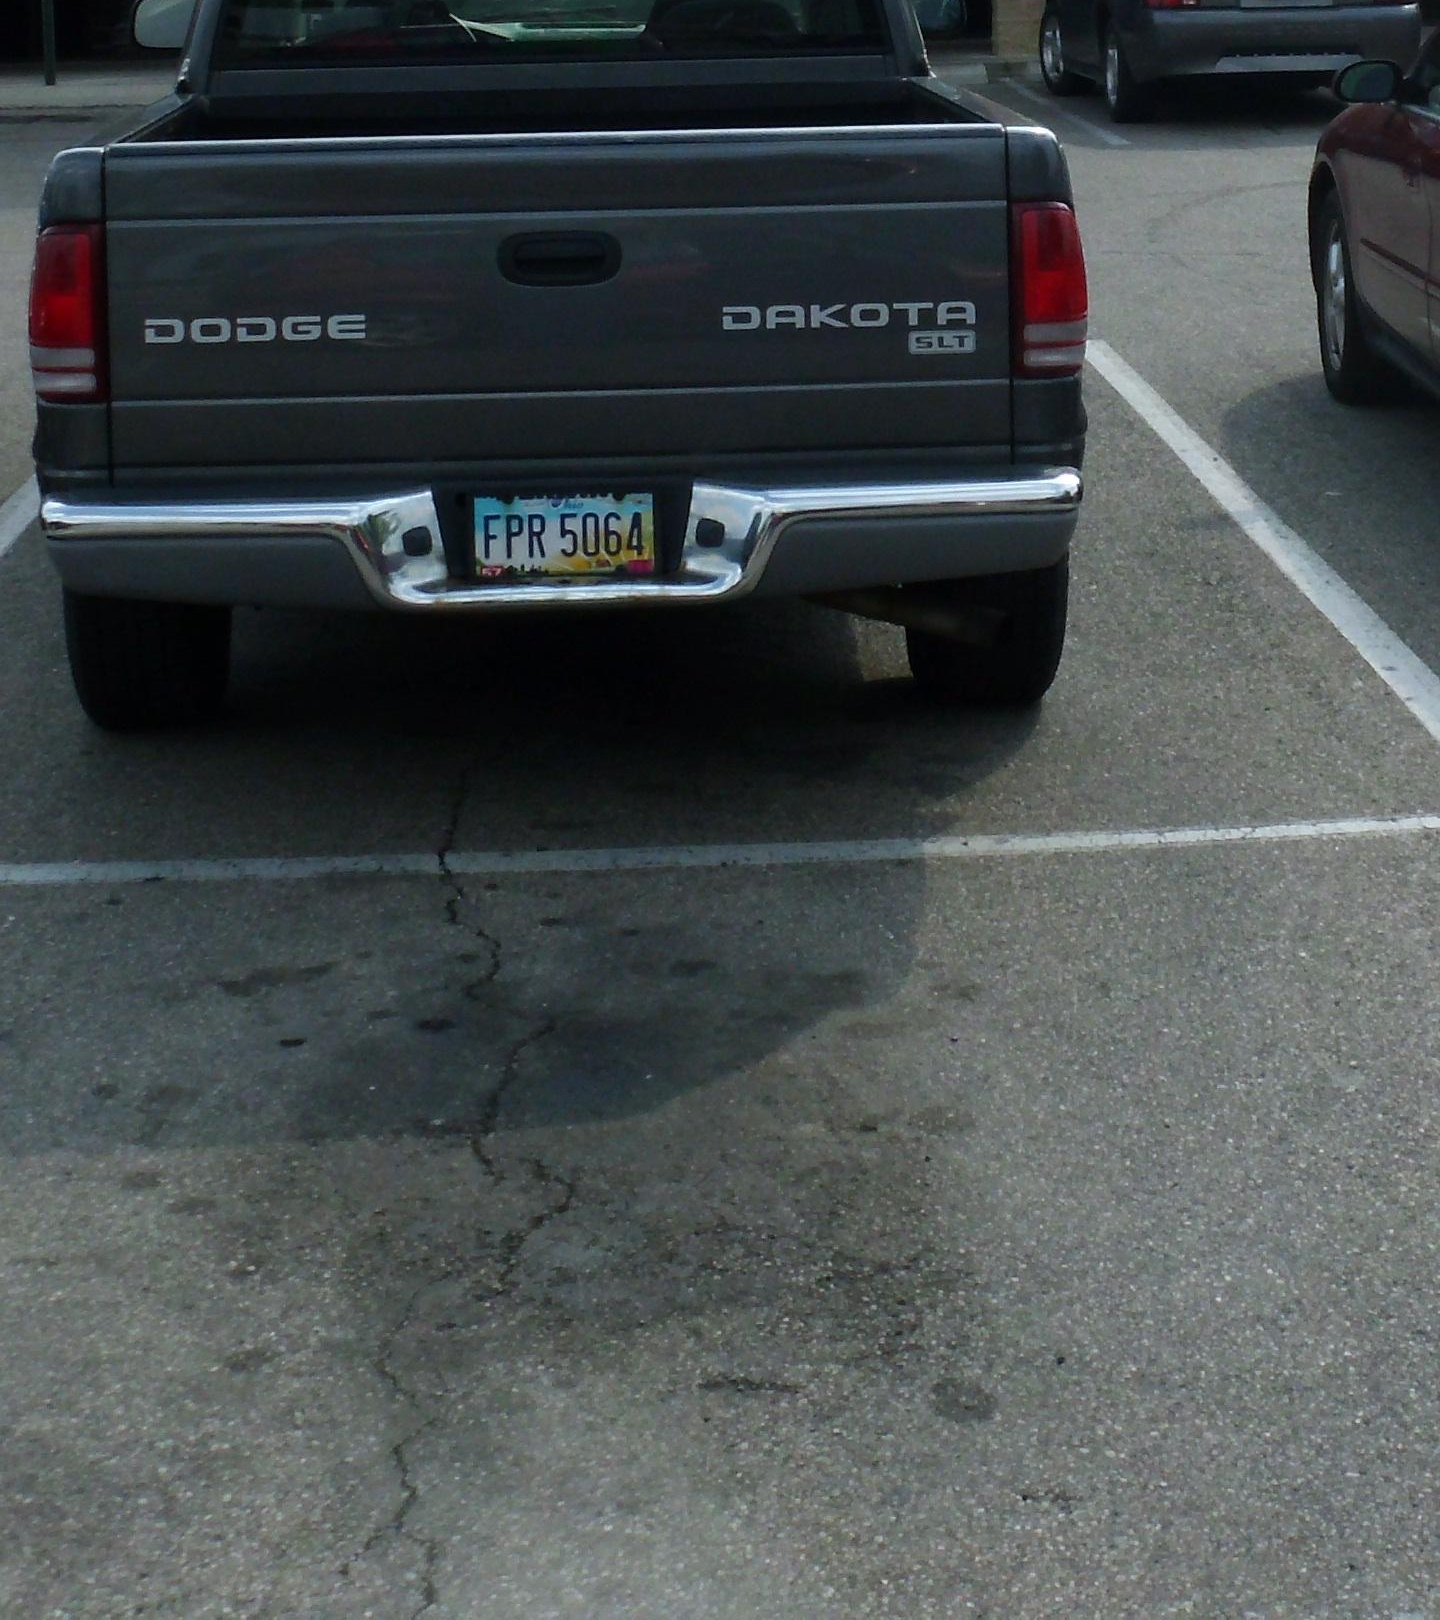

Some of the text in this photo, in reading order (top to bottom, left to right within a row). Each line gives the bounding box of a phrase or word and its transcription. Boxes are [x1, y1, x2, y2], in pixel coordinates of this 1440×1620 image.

[144, 314, 367, 343] DODGE
[722, 301, 977, 330] DAKOTA
[915, 335, 969, 349] SLT
[483, 511, 644, 560] FPR 5064
